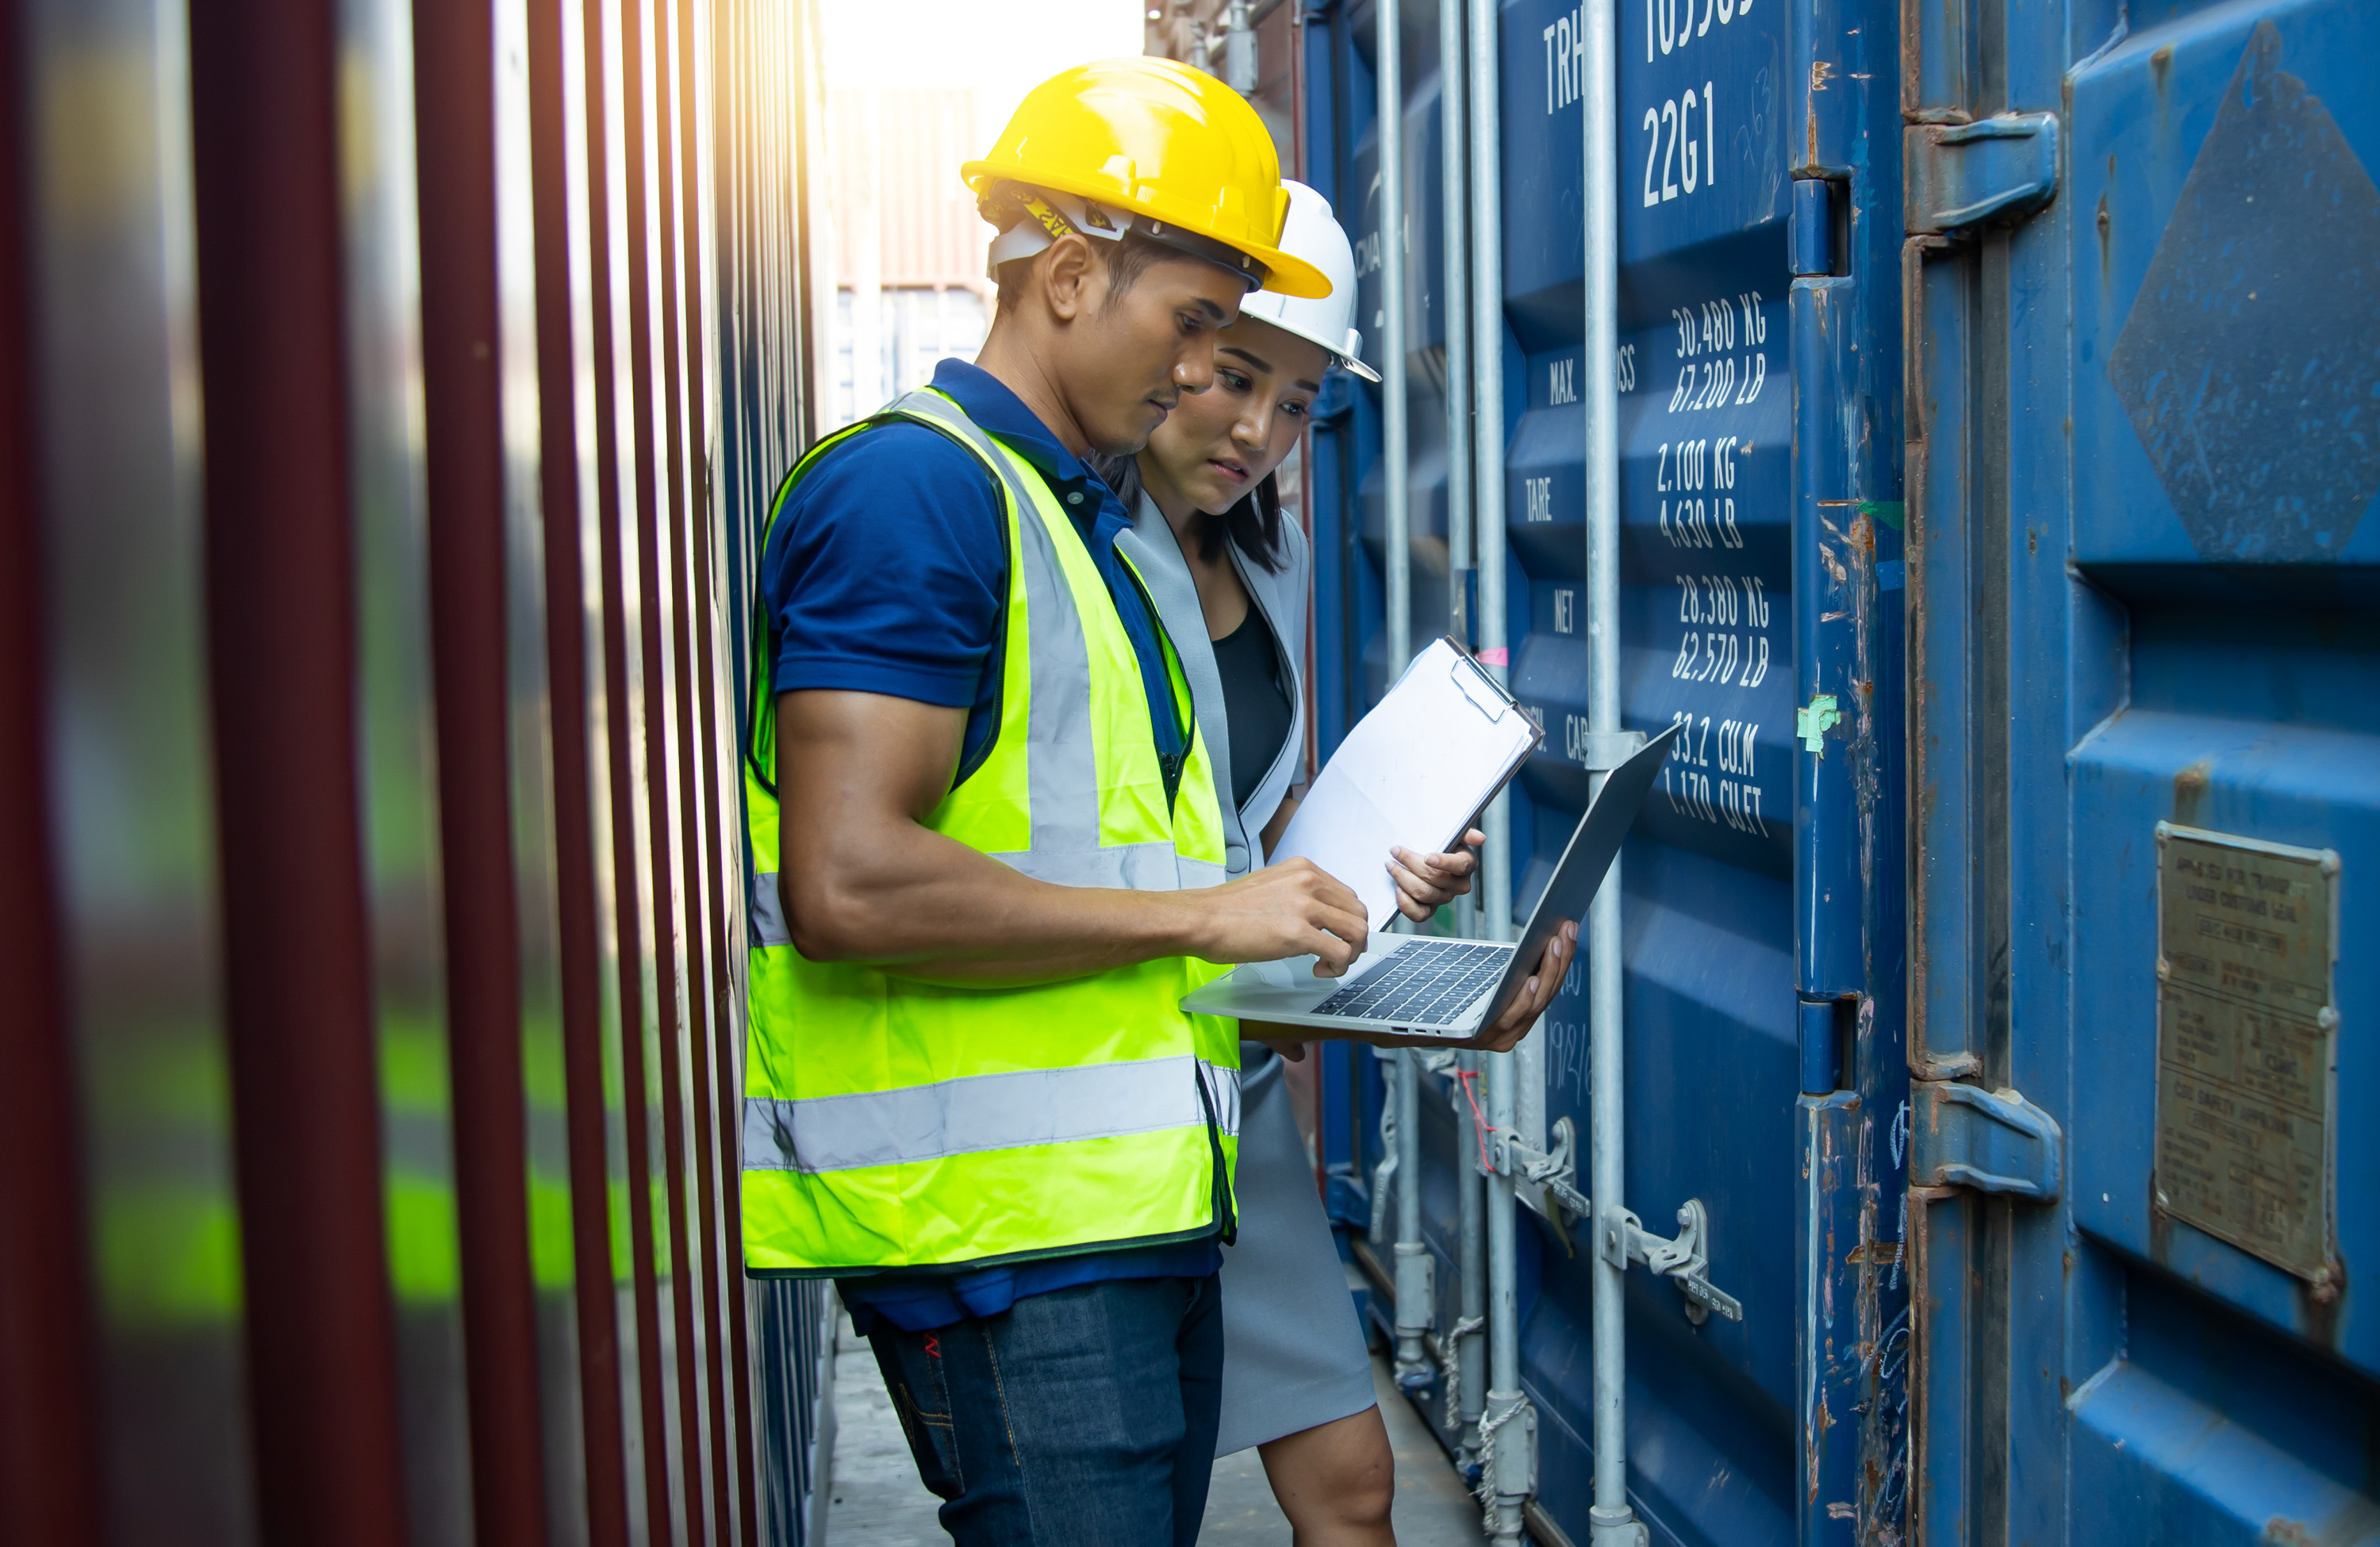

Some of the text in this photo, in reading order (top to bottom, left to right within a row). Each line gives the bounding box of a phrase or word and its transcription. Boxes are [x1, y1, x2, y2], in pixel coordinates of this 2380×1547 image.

[1544, 6, 1584, 115] TRH
[1644, 81, 1714, 208] 22G1
[1672, 290, 1766, 359] 30,480 KG
[1550, 359, 1576, 405] MAX.
[1668, 358, 1735, 413] 67,200
[1735, 352, 1766, 405] LB
[1658, 436, 1737, 492] 2,100 KG
[1526, 477, 1552, 522] TARE
[1714, 498, 1743, 548] LB
[1555, 589, 1573, 634] NET
[1676, 574, 1769, 628] 28,380 KG
[1672, 631, 1769, 688] 62,570 LB
[1718, 719, 1759, 777] CU.M
[1720, 779, 1769, 838] CU.FT
